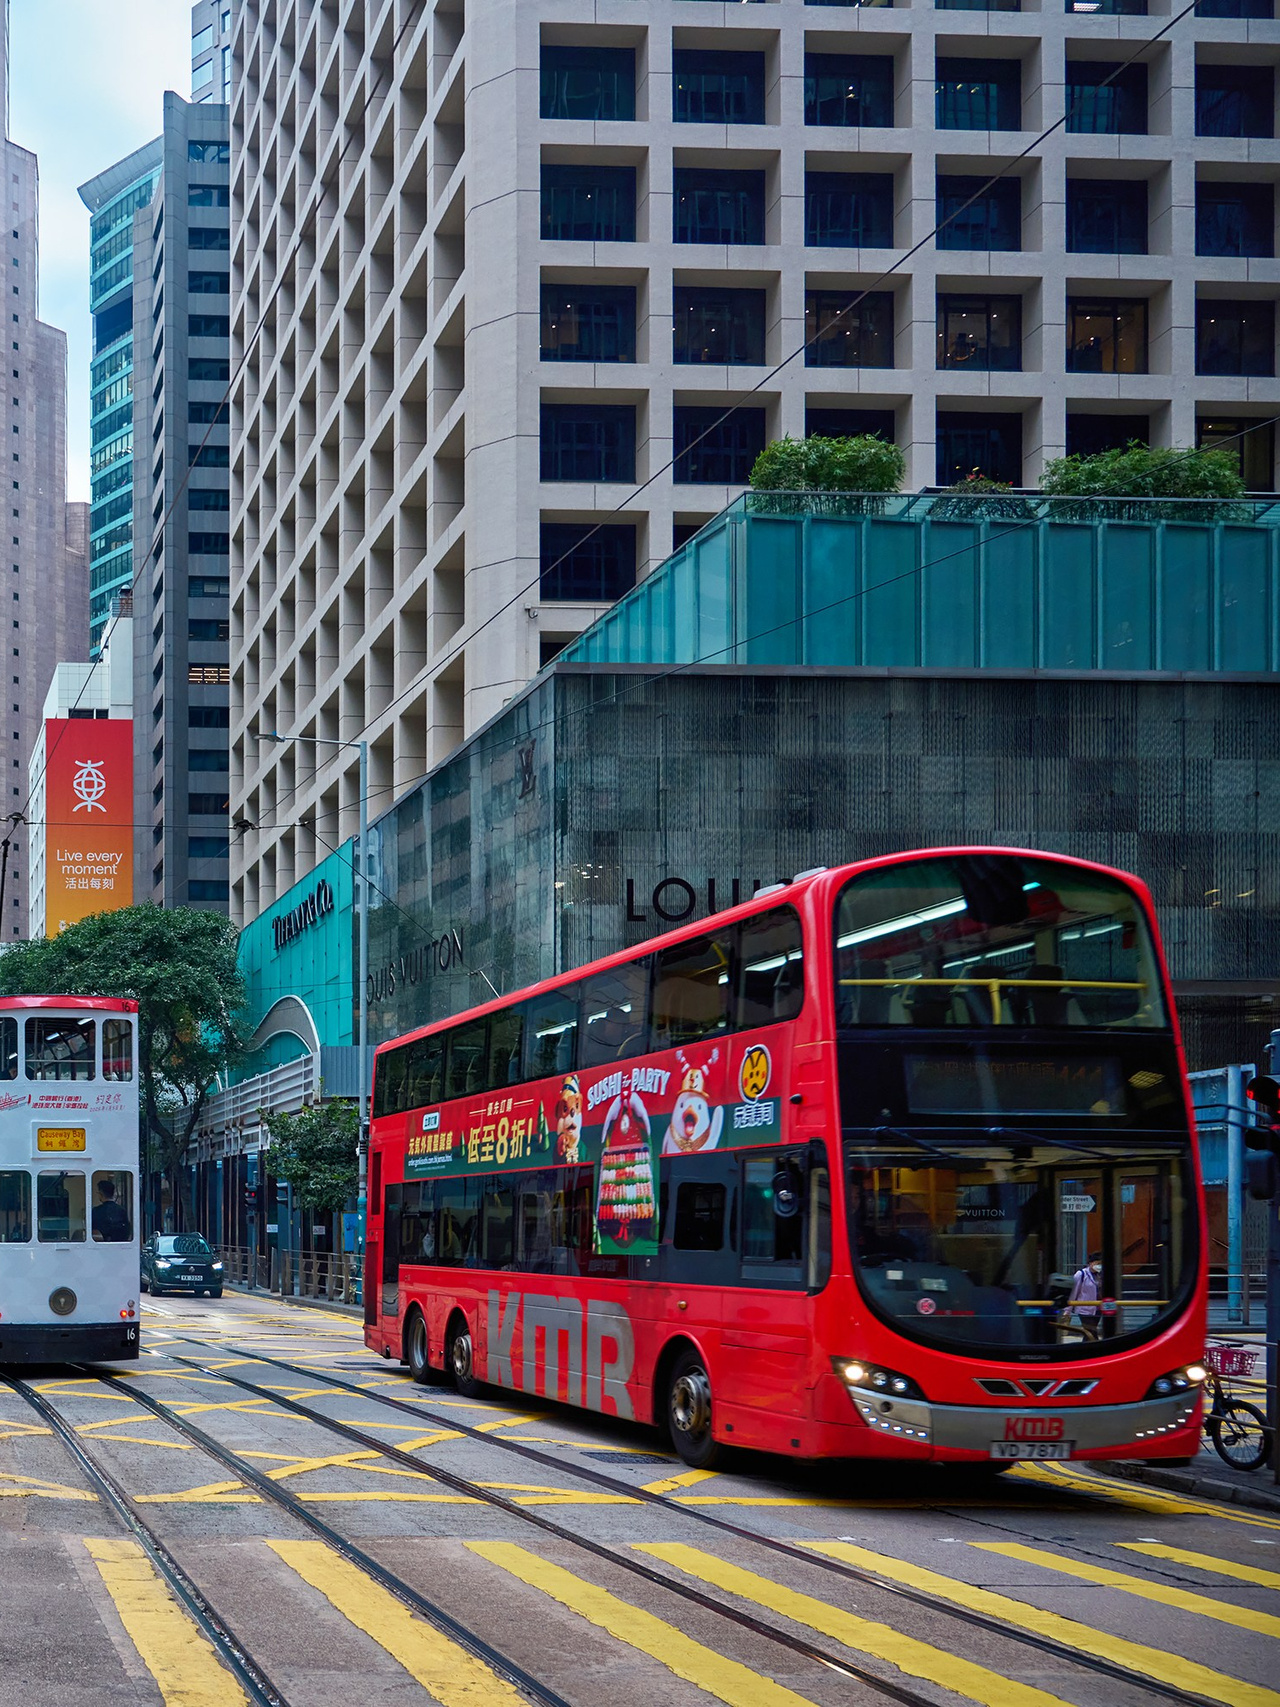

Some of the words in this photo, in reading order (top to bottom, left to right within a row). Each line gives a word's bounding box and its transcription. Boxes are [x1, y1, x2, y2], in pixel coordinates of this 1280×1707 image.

[56, 849, 83, 862] Live
[86, 850, 123, 865] every
[61, 863, 118, 875] moment
[65, 877, 114, 890] 活出每刻
[400, 927, 465, 987] VUITTON
[122, 1002, 131, 1012] 16
[631, 1067, 671, 1096] PARTY
[587, 1071, 623, 1111] SUSHI
[40, 1130, 70, 1139] Causeway
[72, 1130, 85, 1139] Bay
[468, 1117, 533, 1164] 低至8折!
[965, 1209, 1005, 1217] VUITTON
[126, 1328, 136, 1340] 16
[1025, 1444, 1064, 1457] 7871
